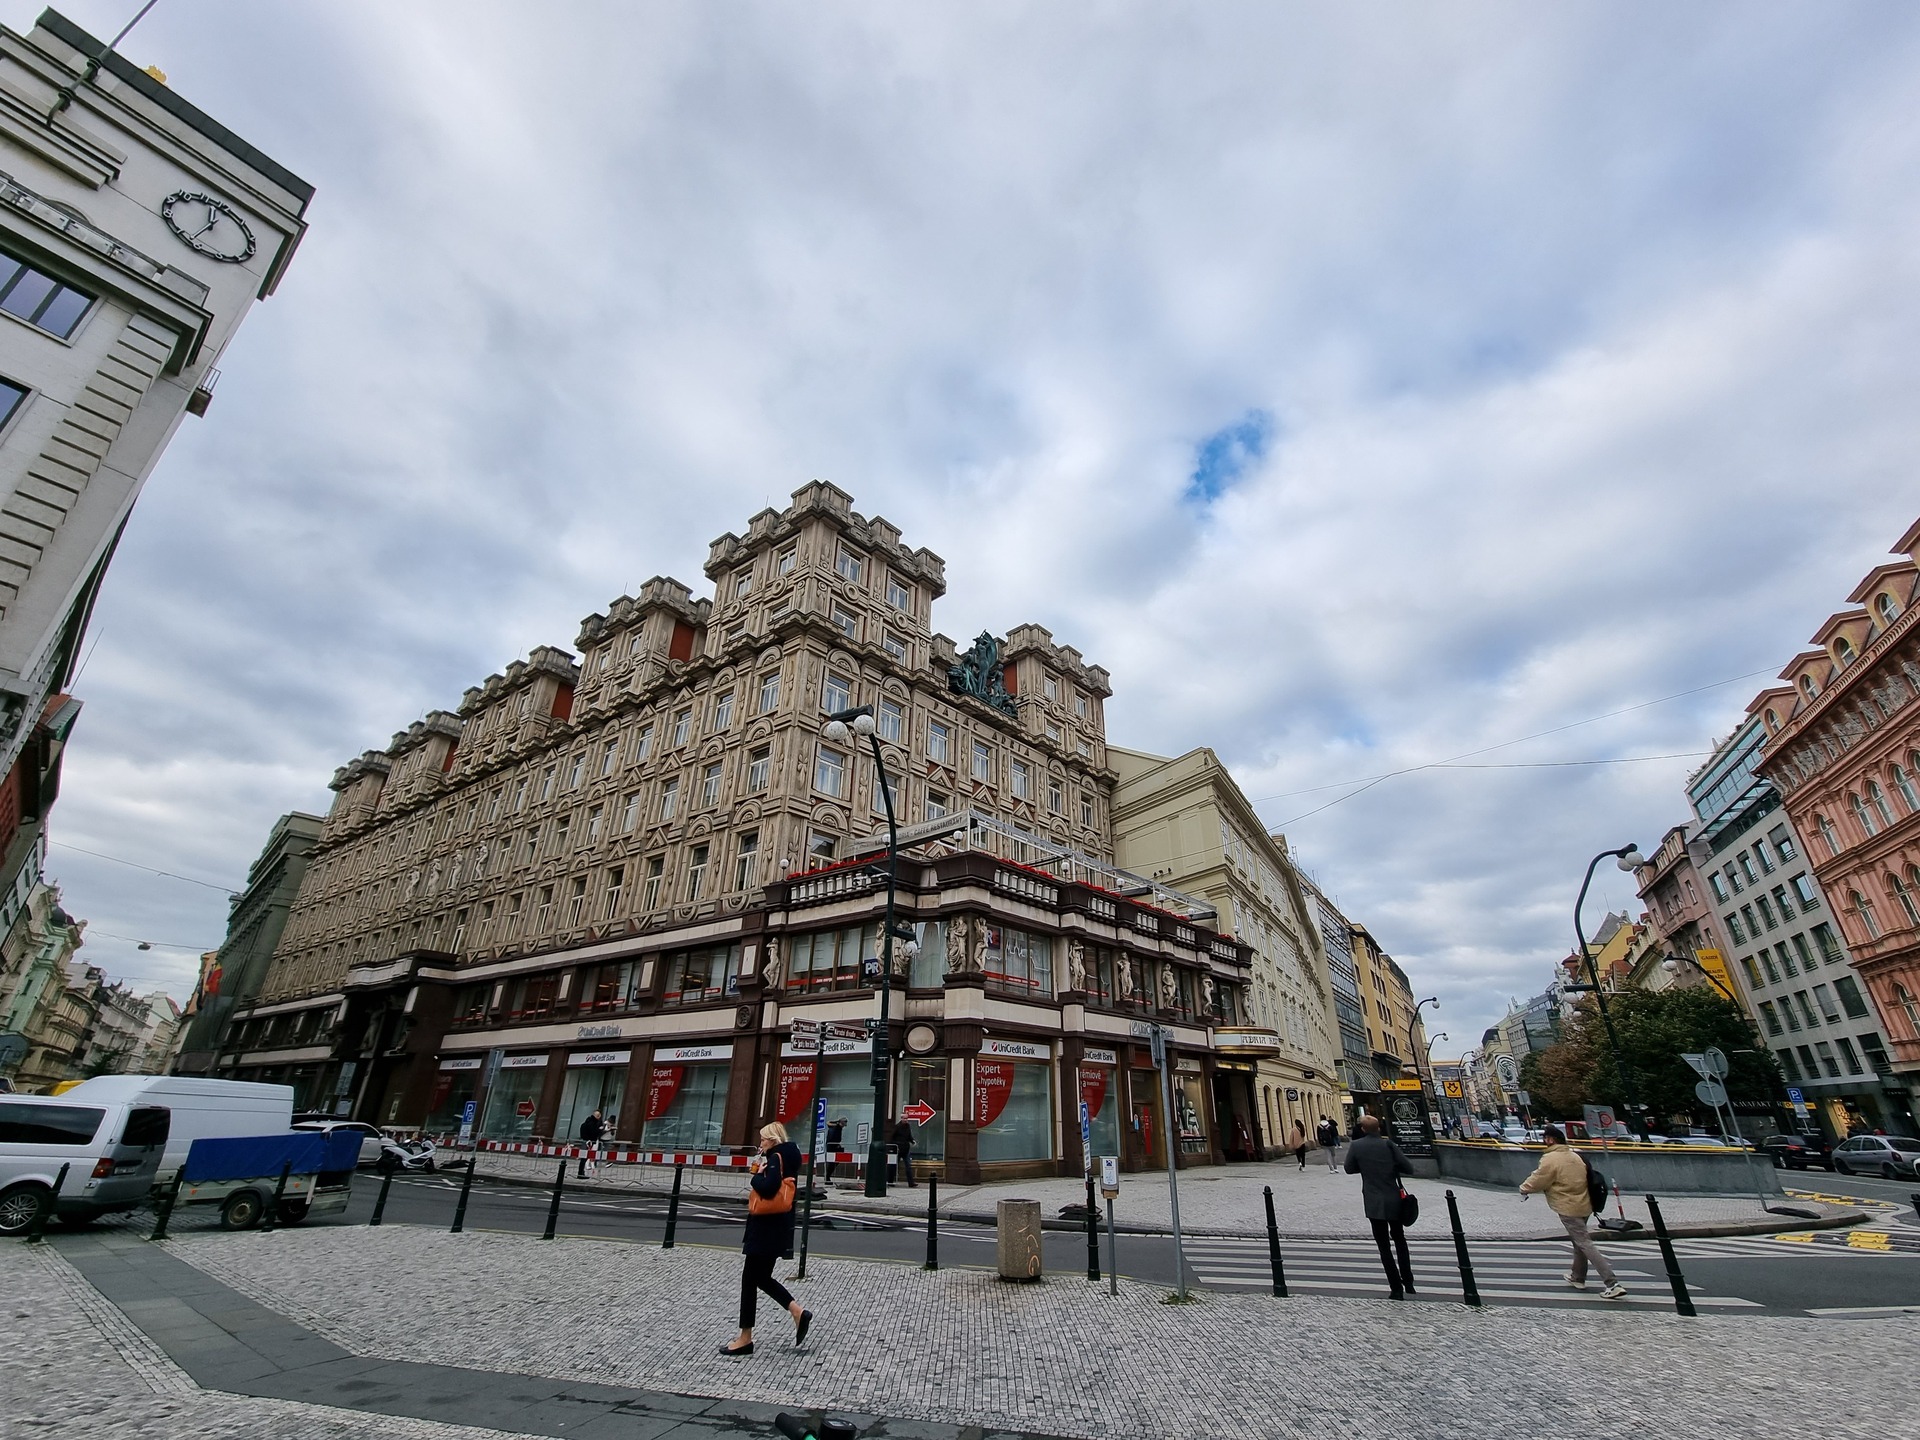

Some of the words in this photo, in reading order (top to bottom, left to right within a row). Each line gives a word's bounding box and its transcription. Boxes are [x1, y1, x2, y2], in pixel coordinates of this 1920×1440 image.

[840, 1042, 855, 1050] Bank
[998, 1043, 1021, 1054] UniCredit
[1022, 1046, 1035, 1055] Bank
[681, 1050, 700, 1058] UniCredit
[700, 1049, 713, 1057] Bank
[1103, 1052, 1114, 1061] Bank
[653, 1068, 672, 1079] Expert
[781, 1063, 813, 1074] Prémiové
[977, 1062, 1001, 1075] Expert
[1790, 1090, 1798, 1099] P
[466, 1104, 474, 1118] P
